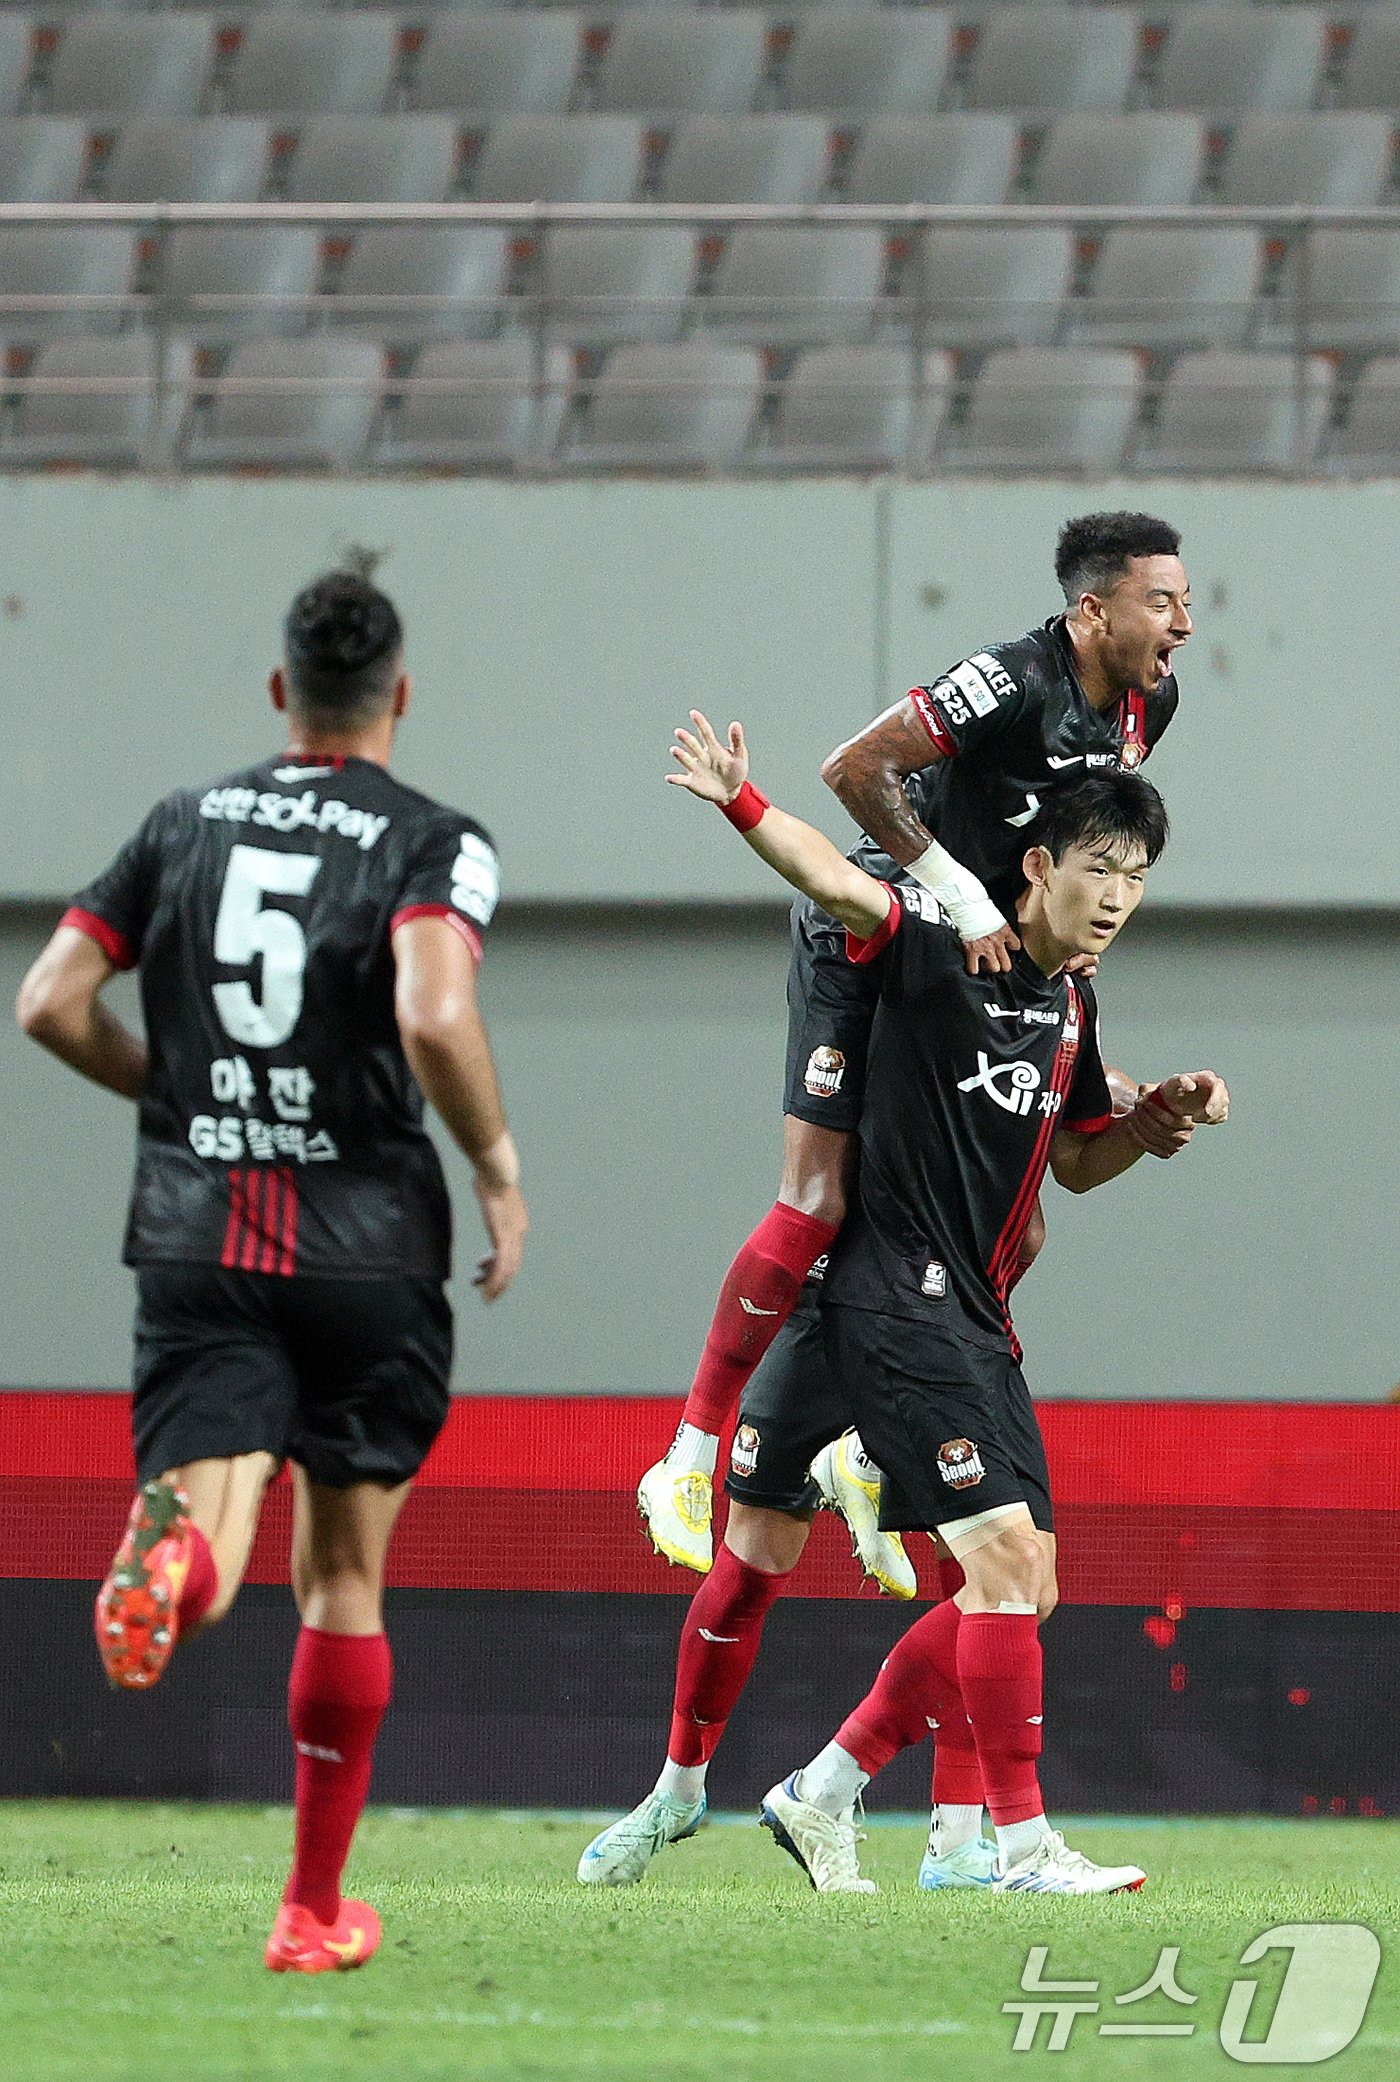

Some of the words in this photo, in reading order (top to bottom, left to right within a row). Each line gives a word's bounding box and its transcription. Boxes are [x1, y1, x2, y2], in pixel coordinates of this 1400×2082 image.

[934, 682, 972, 725] 625
[211, 844, 322, 1049] 5
[936, 1450, 985, 1482] Seoul
